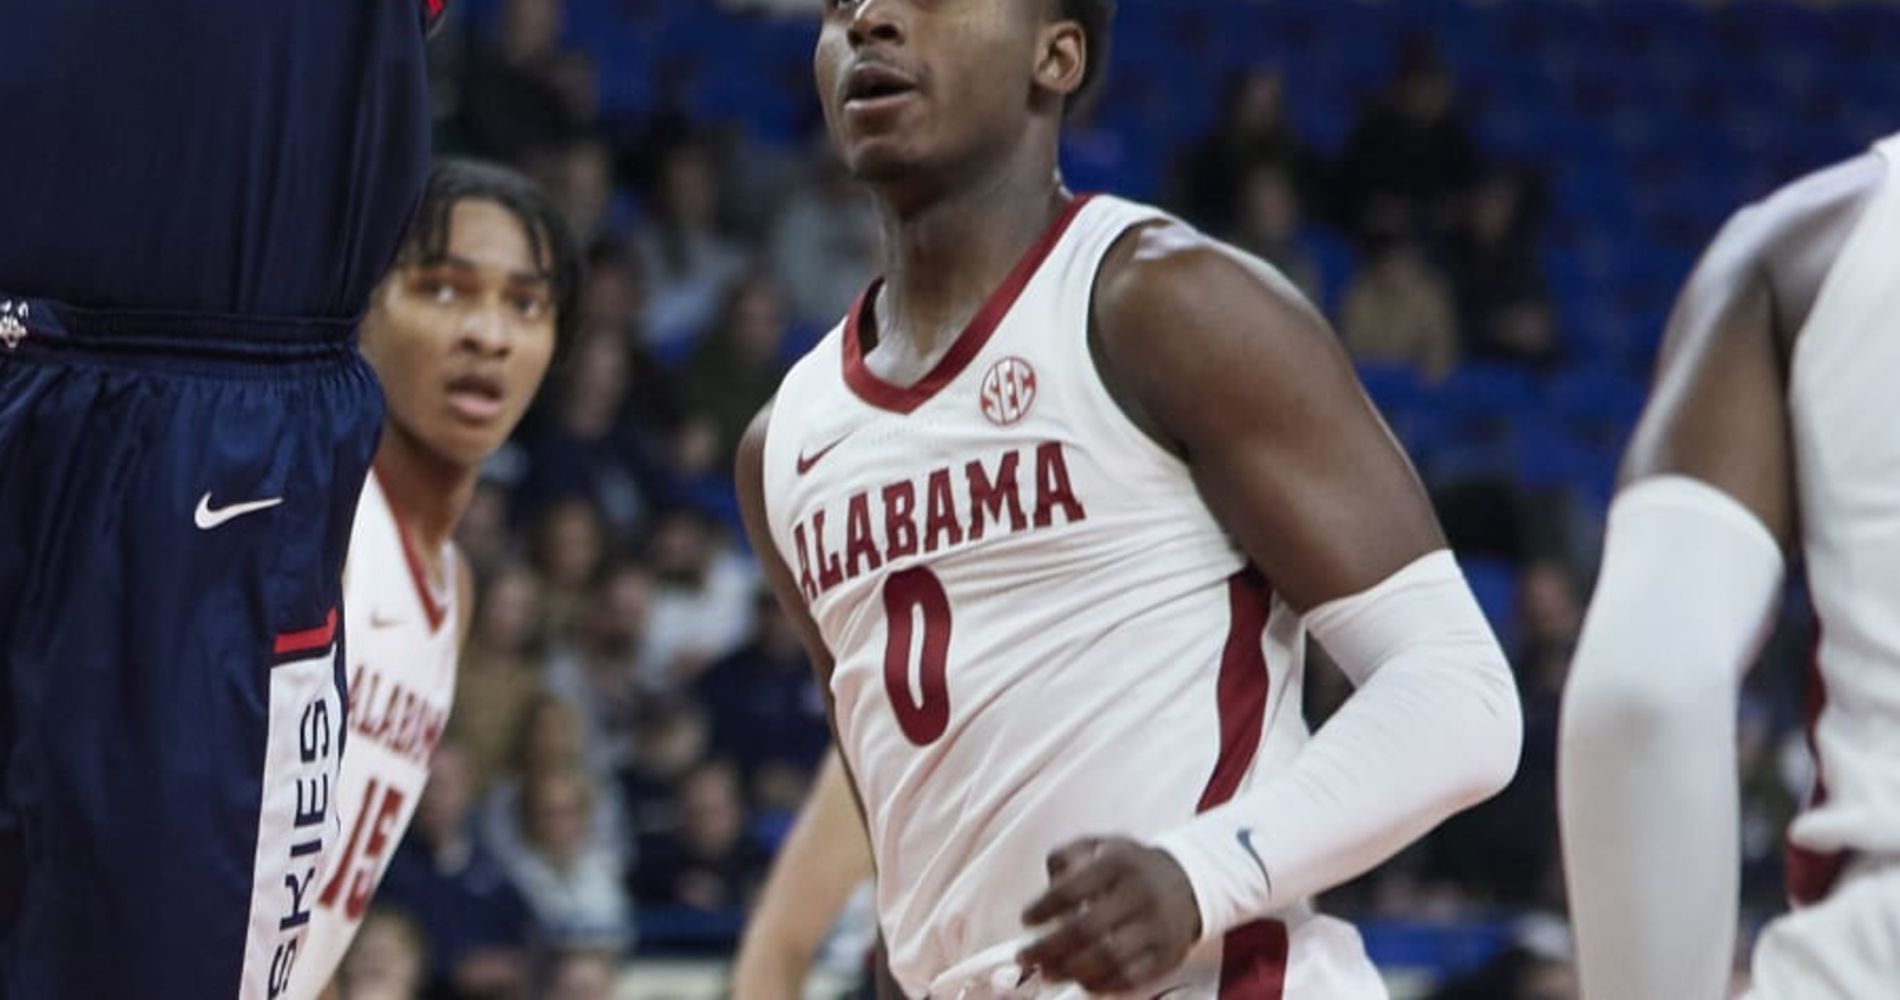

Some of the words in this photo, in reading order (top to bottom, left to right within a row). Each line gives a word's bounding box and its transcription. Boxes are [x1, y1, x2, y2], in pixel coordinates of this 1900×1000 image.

[981, 356, 1036, 427] SEC
[794, 440, 1087, 601] ALABAMA
[882, 565, 952, 747] 0
[319, 777, 405, 921] 15
